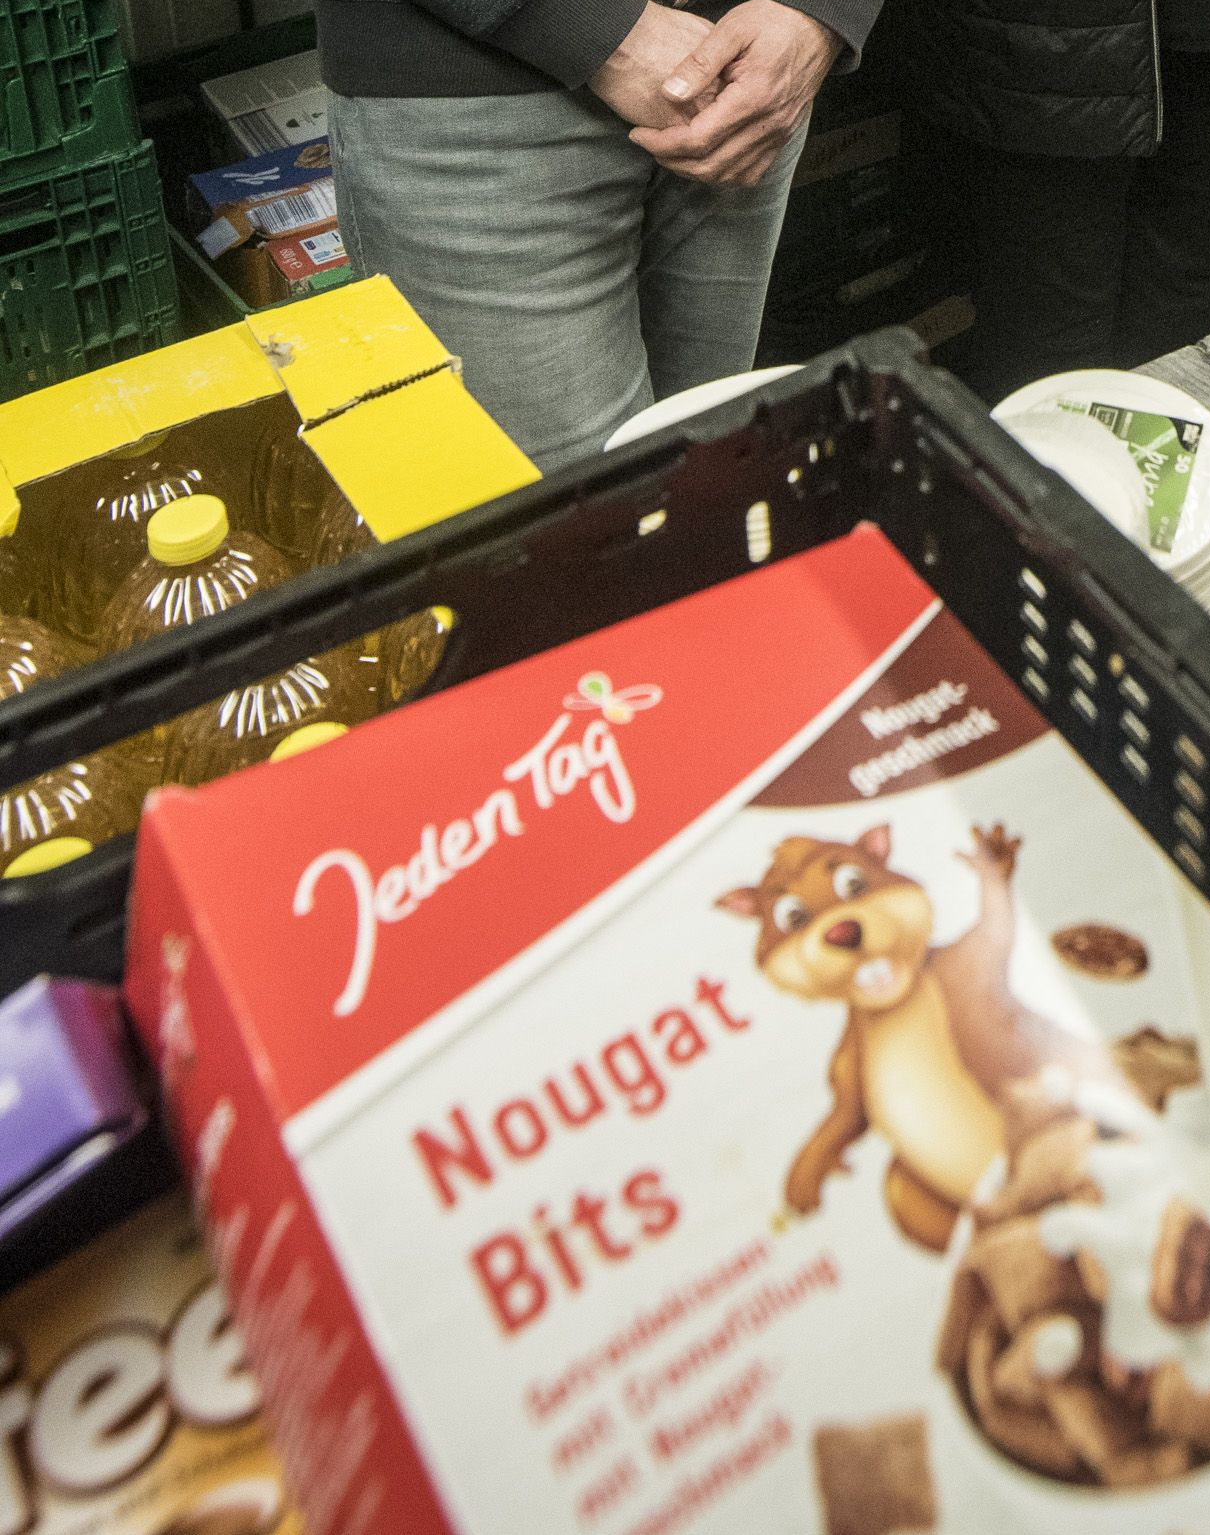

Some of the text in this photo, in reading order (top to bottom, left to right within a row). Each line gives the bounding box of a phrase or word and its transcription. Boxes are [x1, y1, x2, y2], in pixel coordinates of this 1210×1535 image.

[849, 706, 1000, 797] geschmack
[861, 680, 969, 739] Nougat-
[293, 788, 525, 1018] Jeden
[502, 712, 637, 824] Tag
[411, 976, 752, 1211] Nougat
[470, 1169, 681, 1338] Bits
